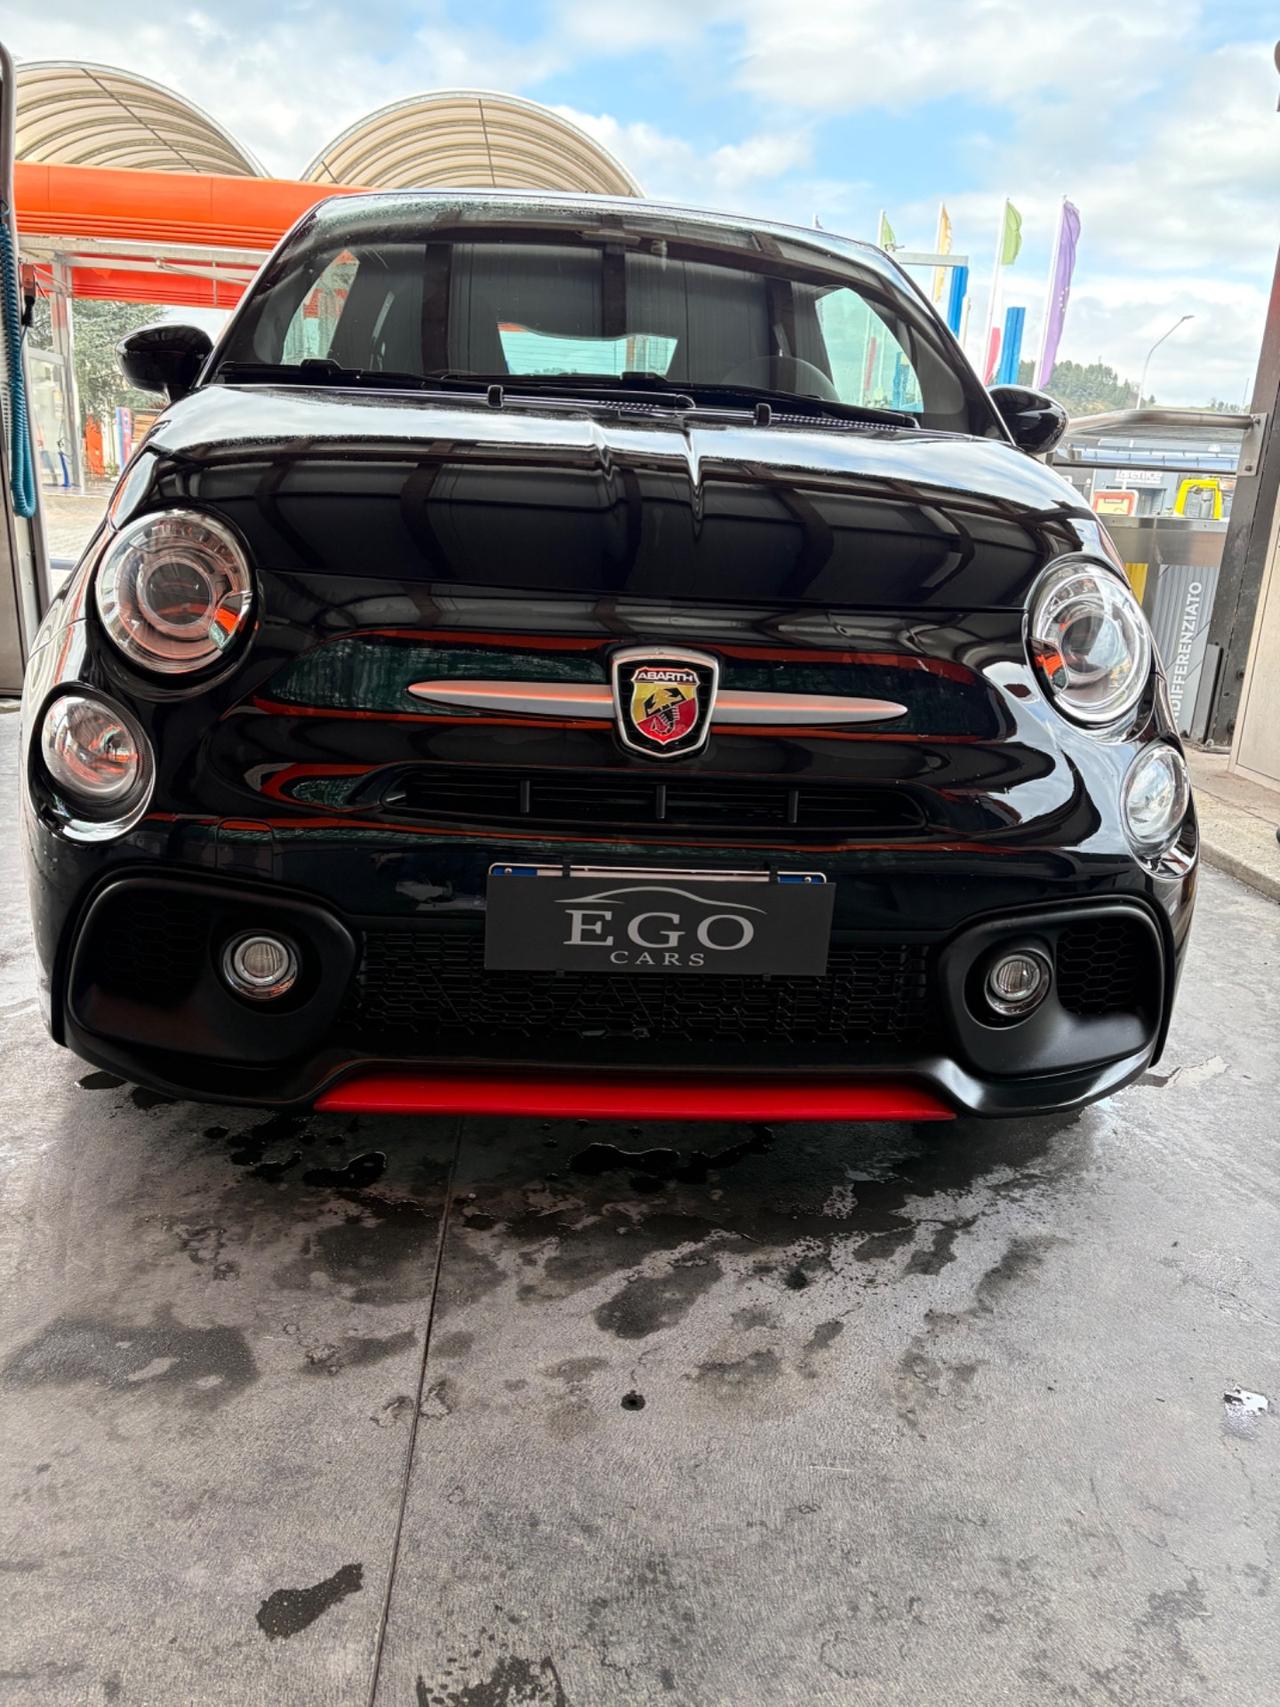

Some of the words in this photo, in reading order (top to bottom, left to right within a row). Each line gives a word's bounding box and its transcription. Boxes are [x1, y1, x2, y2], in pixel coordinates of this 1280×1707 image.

[637, 671, 694, 682] ABARTH
[562, 909, 755, 951] EGO
[609, 951, 706, 967] CARS
